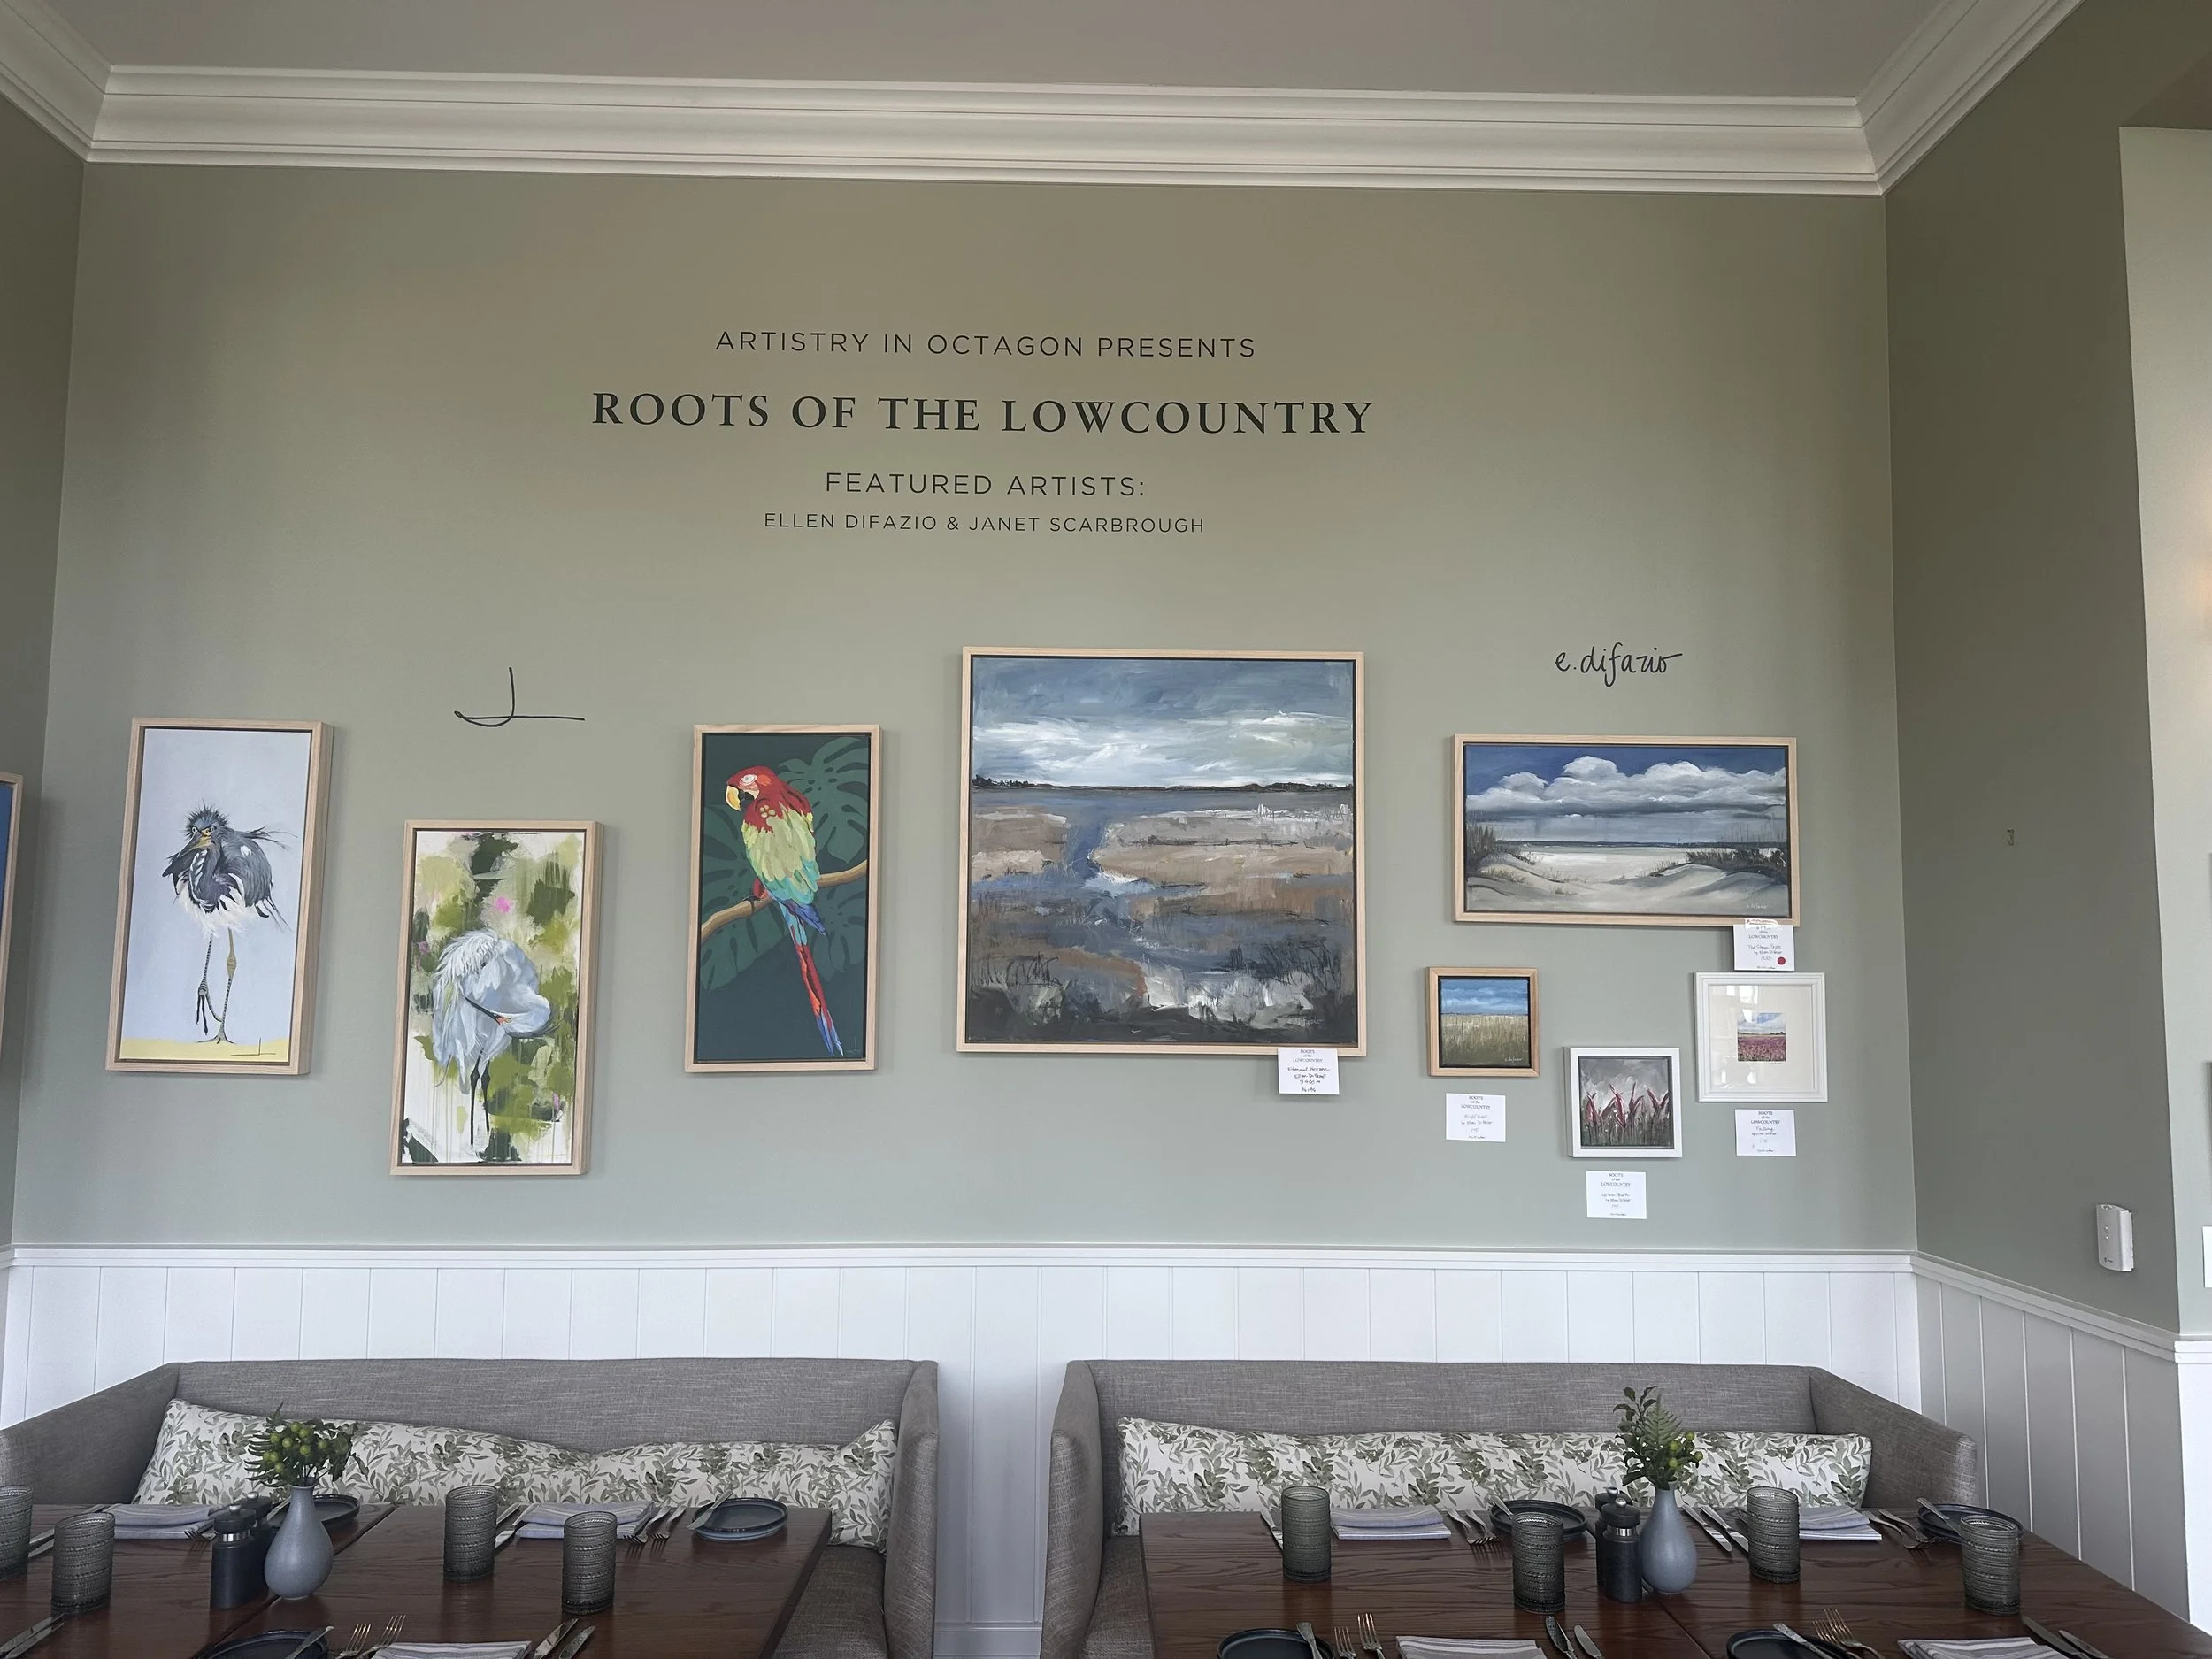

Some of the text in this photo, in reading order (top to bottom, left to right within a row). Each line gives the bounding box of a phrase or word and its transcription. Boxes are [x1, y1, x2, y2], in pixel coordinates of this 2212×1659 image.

[715, 330, 1256, 359] ARTISTRY IN OCTAGON PRESENTS
[592, 391, 1374, 434] ROOTS OF THE LOWCOUNTRY
[826, 472, 1145, 497] FEATURED ARTISTS:
[764, 512, 1204, 534] ELLEN DIFAZIO & JANET SCARBROUGH
